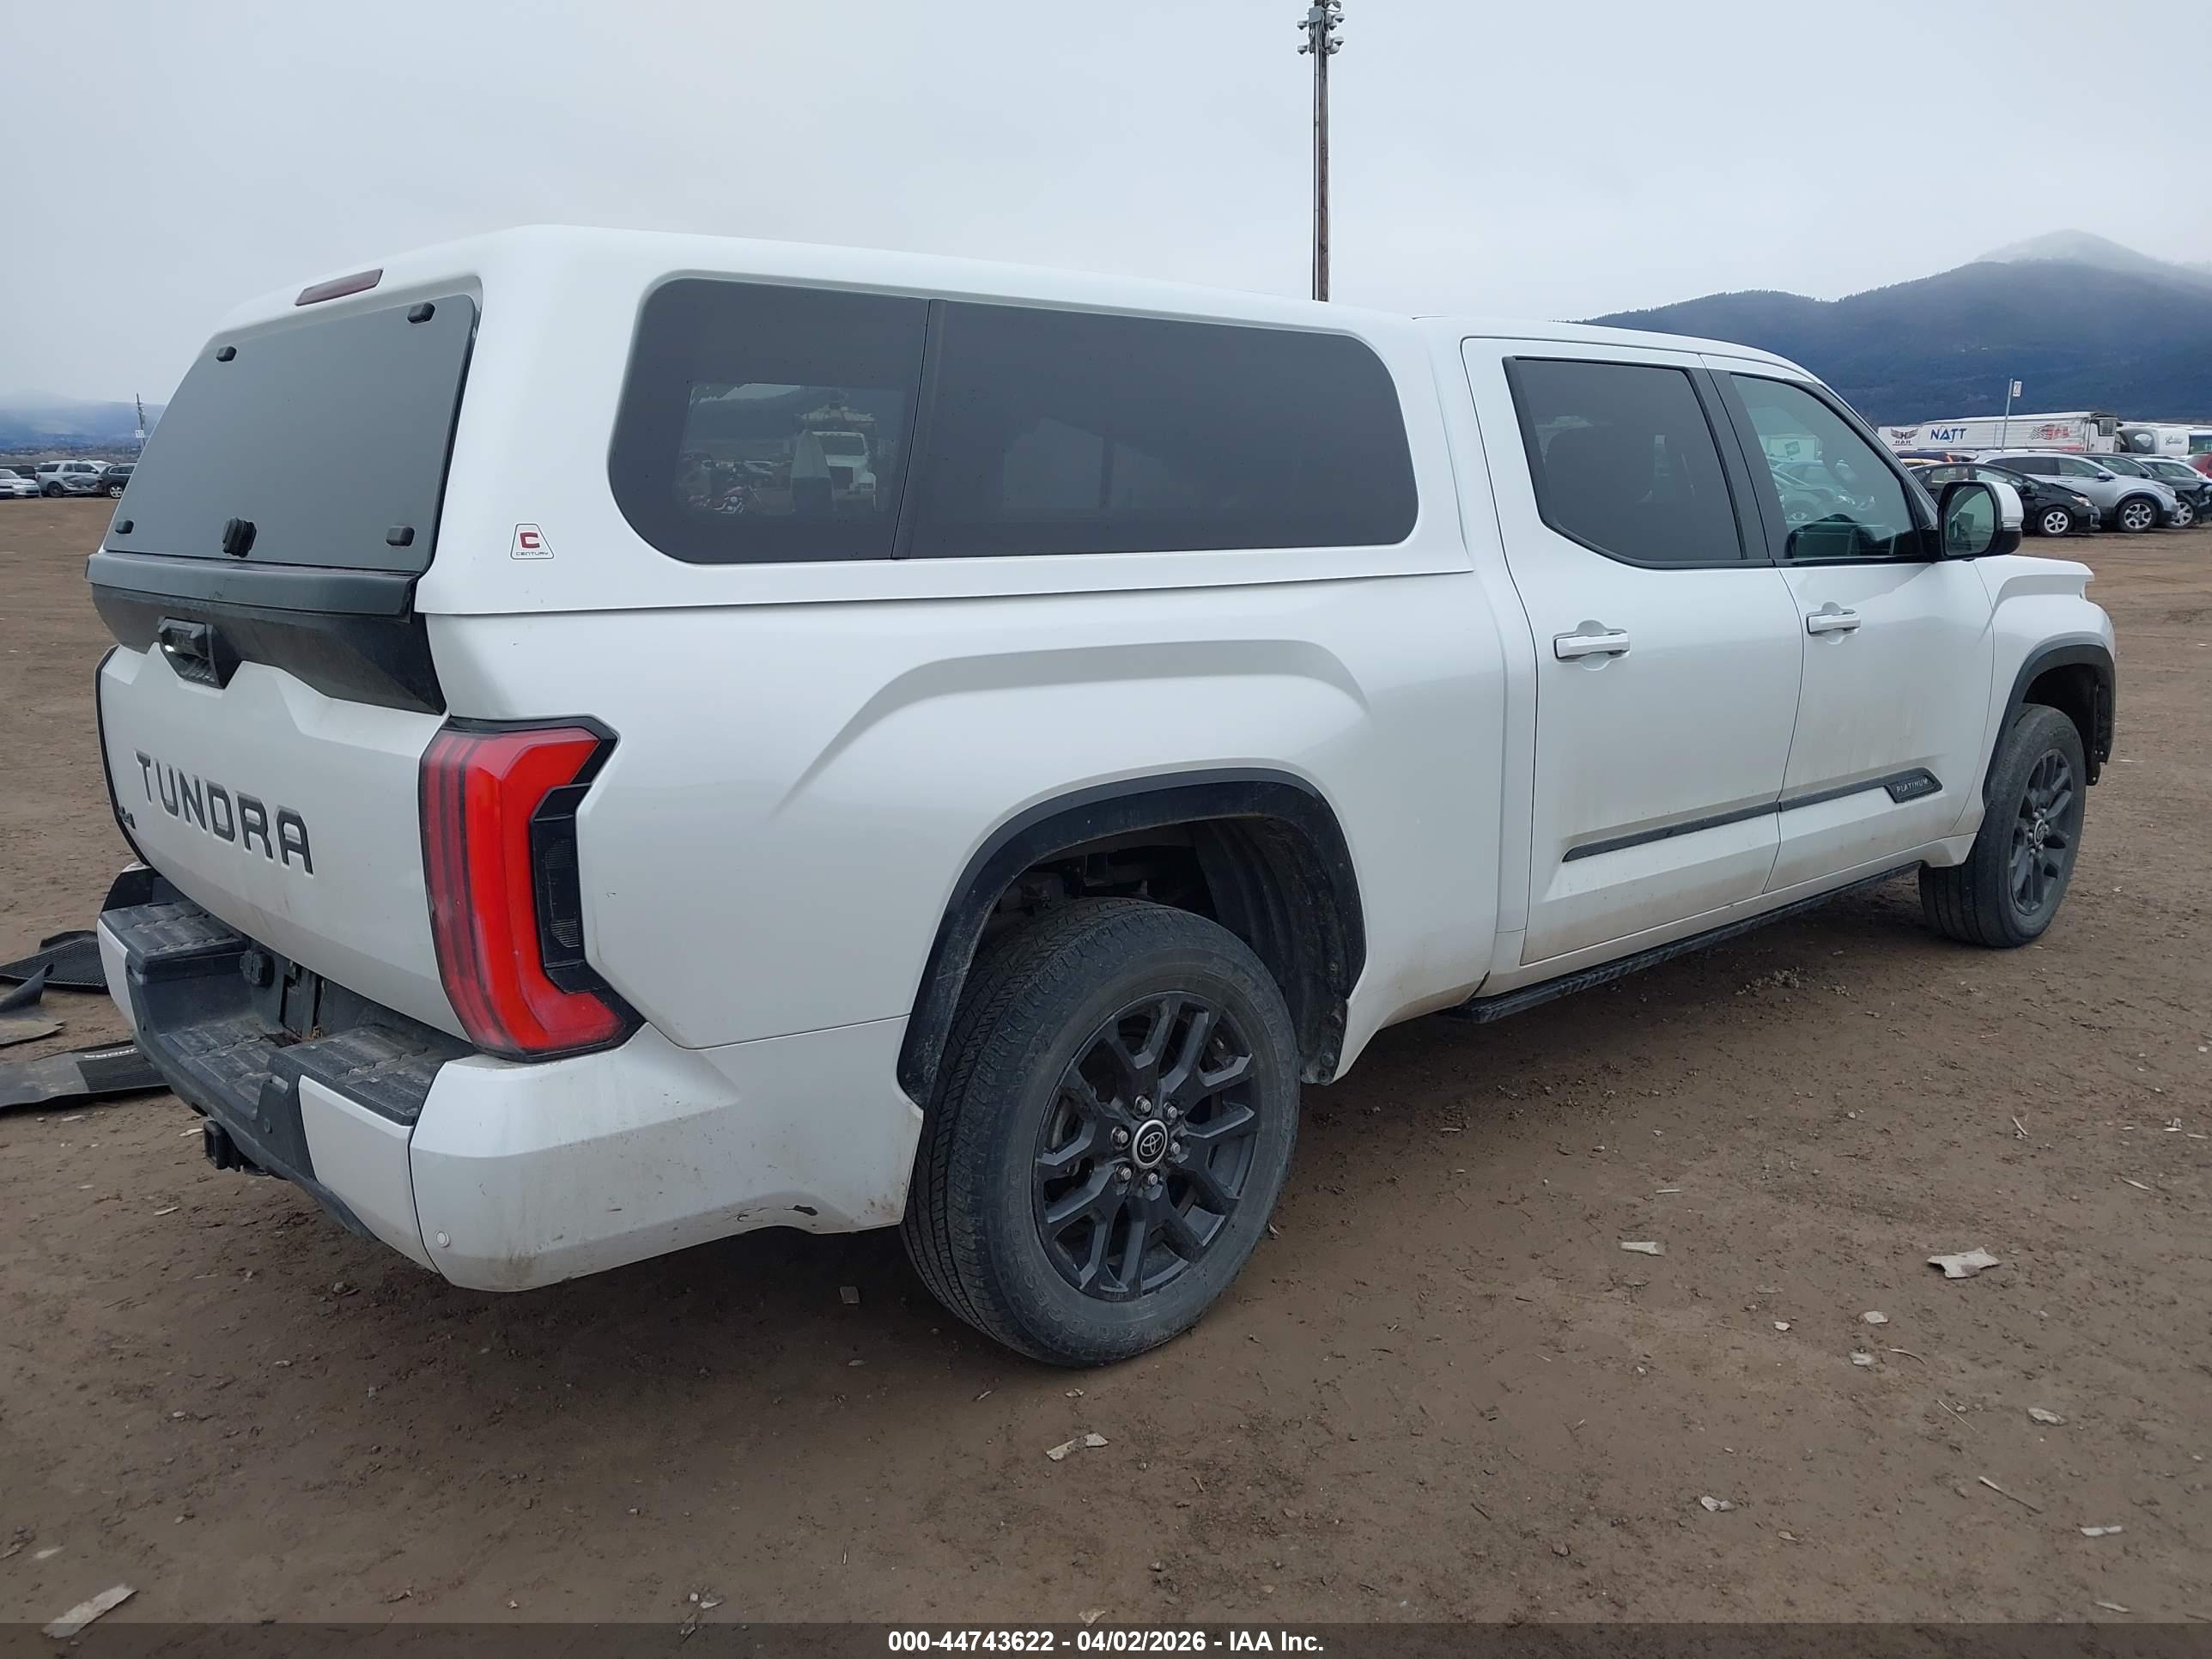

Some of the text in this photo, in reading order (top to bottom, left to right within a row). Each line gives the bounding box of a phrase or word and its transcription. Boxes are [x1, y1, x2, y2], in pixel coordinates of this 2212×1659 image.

[1930, 428, 1967, 443] NATT
[1896, 777, 1929, 793] PLATINUM
[134, 749, 314, 876] TUNDRA
